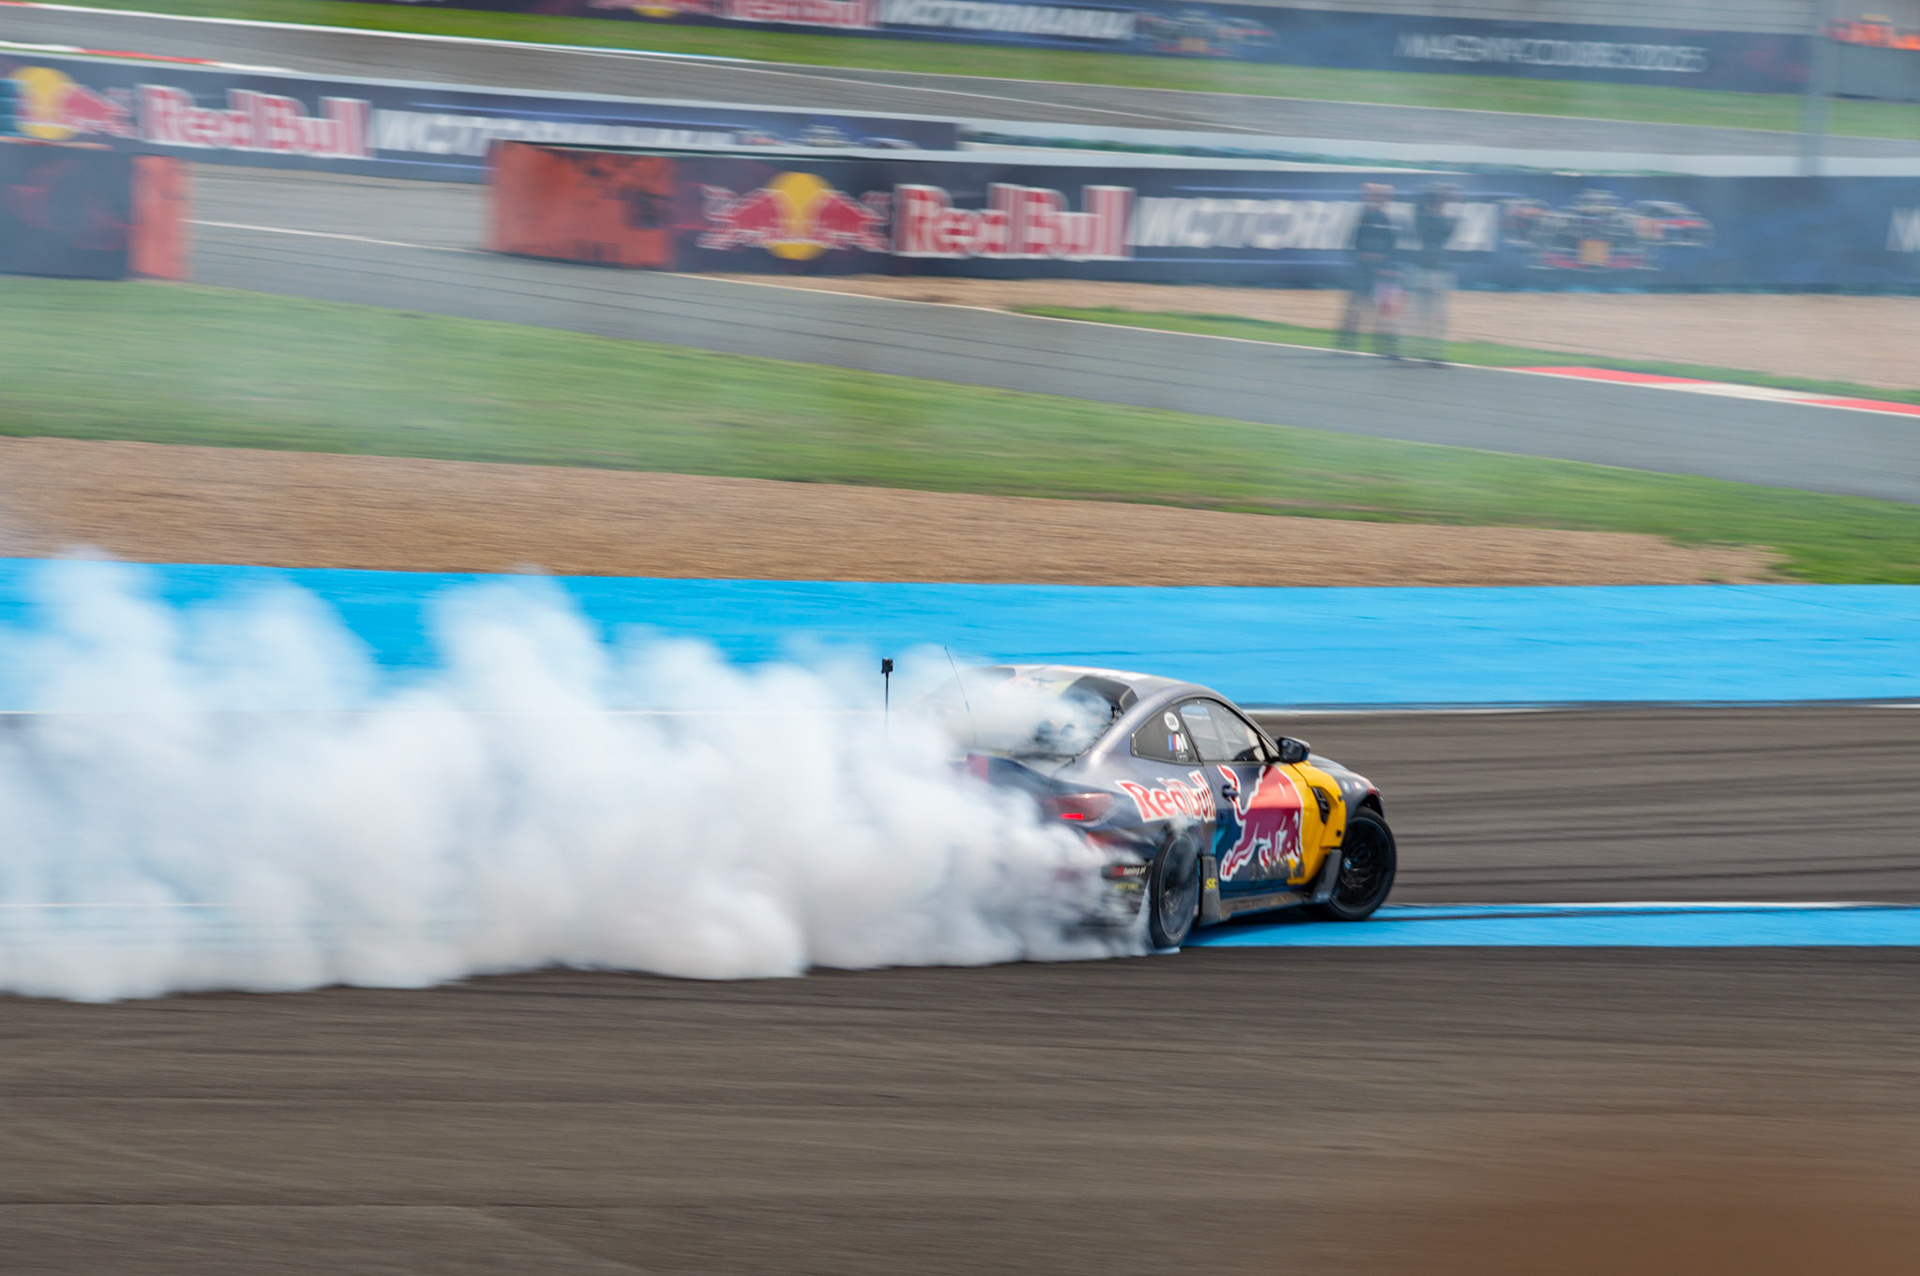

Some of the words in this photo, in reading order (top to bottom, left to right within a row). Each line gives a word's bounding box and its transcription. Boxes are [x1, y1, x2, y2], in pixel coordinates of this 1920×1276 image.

[134, 83, 255, 149] Red
[252, 90, 374, 159] Bull
[893, 182, 1020, 260] Red
[1016, 184, 1136, 262] Bull
[1114, 777, 1190, 823] Red
[1167, 769, 1216, 823] Bull
